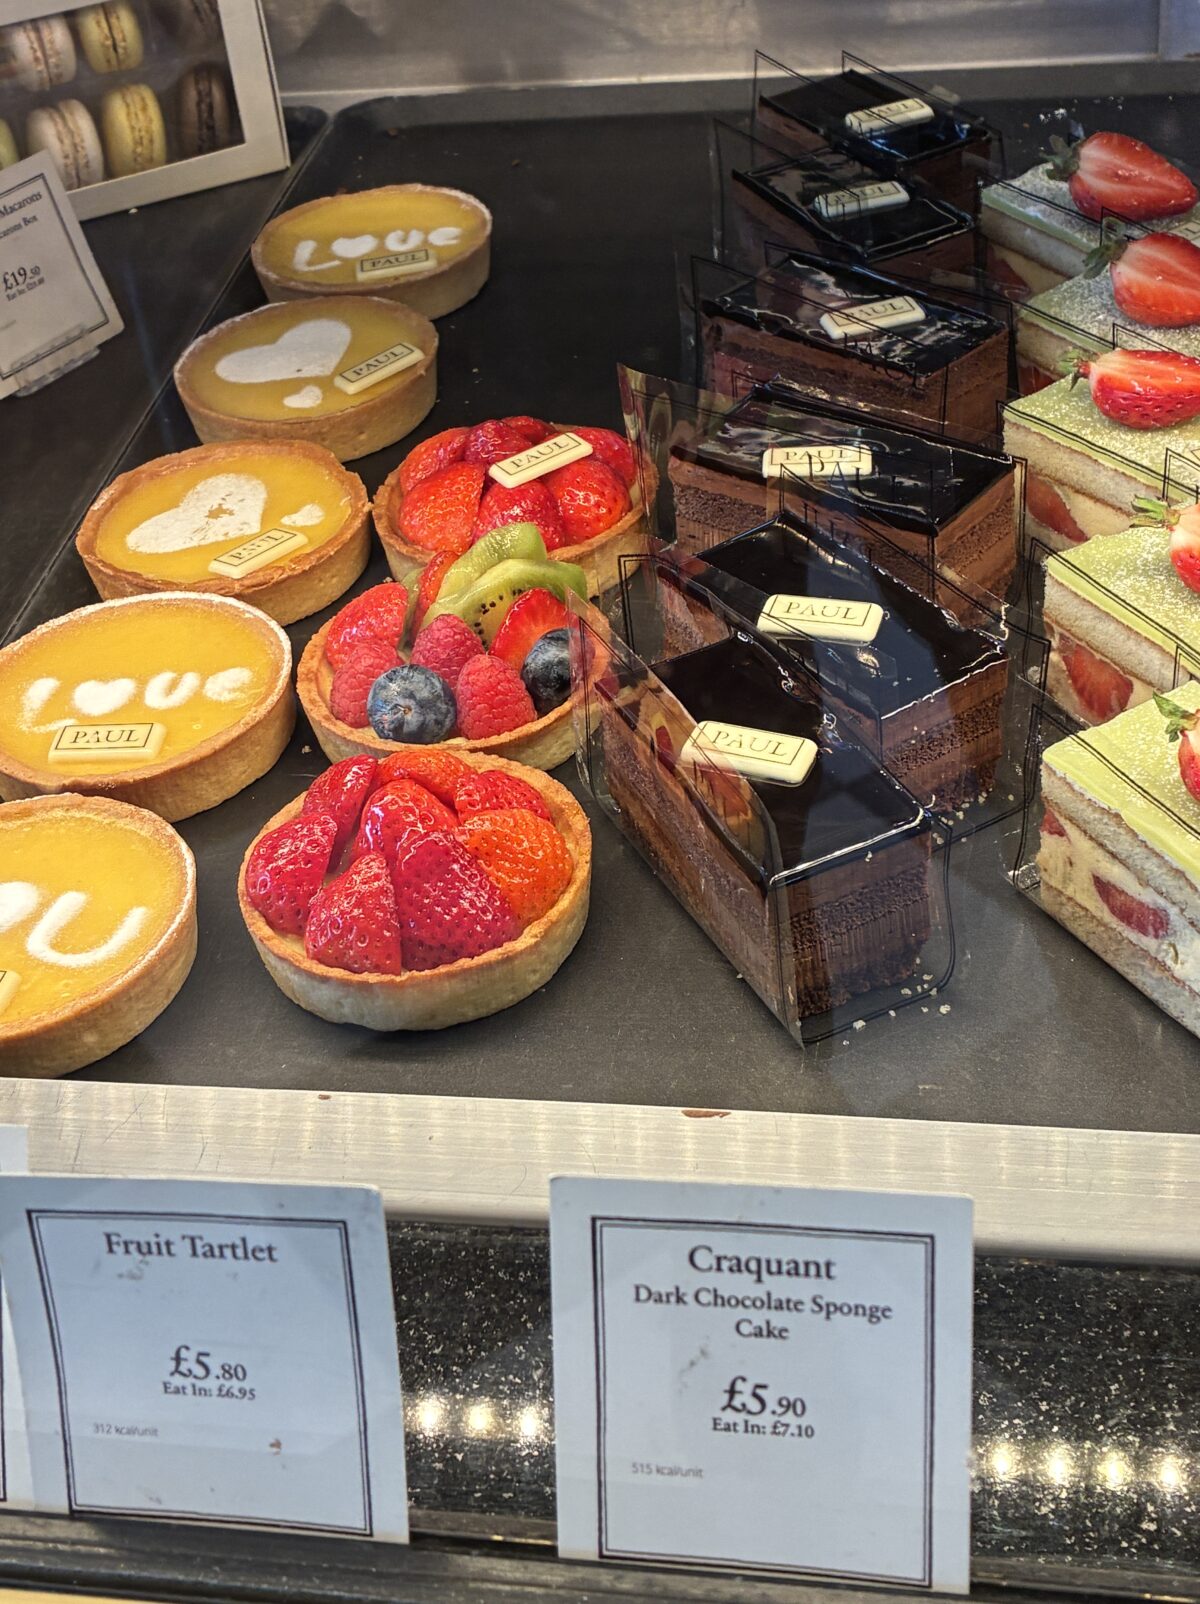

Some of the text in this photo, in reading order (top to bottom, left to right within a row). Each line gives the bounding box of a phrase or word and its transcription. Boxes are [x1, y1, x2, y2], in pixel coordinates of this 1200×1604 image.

[369, 251, 422, 268] PAUL
[352, 349, 404, 377] PAUL
[511, 441, 570, 469] PAUL
[785, 448, 850, 461] PAUL
[229, 533, 284, 561] PAUL
[785, 601, 858, 620] PAUL
[69, 729, 142, 744] PAUL
[707, 730, 789, 758] PAUL
[103, 1231, 279, 1264] Fruit Tartlet
[688, 1245, 836, 1284] Craquant
[633, 1284, 894, 1325] Dark Chocolate Sponge
[734, 1318, 790, 1341] Cake
[162, 1381, 256, 1401] Eat In: £6.95
[711, 1416, 815, 1440] Eat In: £7.10
[631, 1461, 653, 1475] 515
